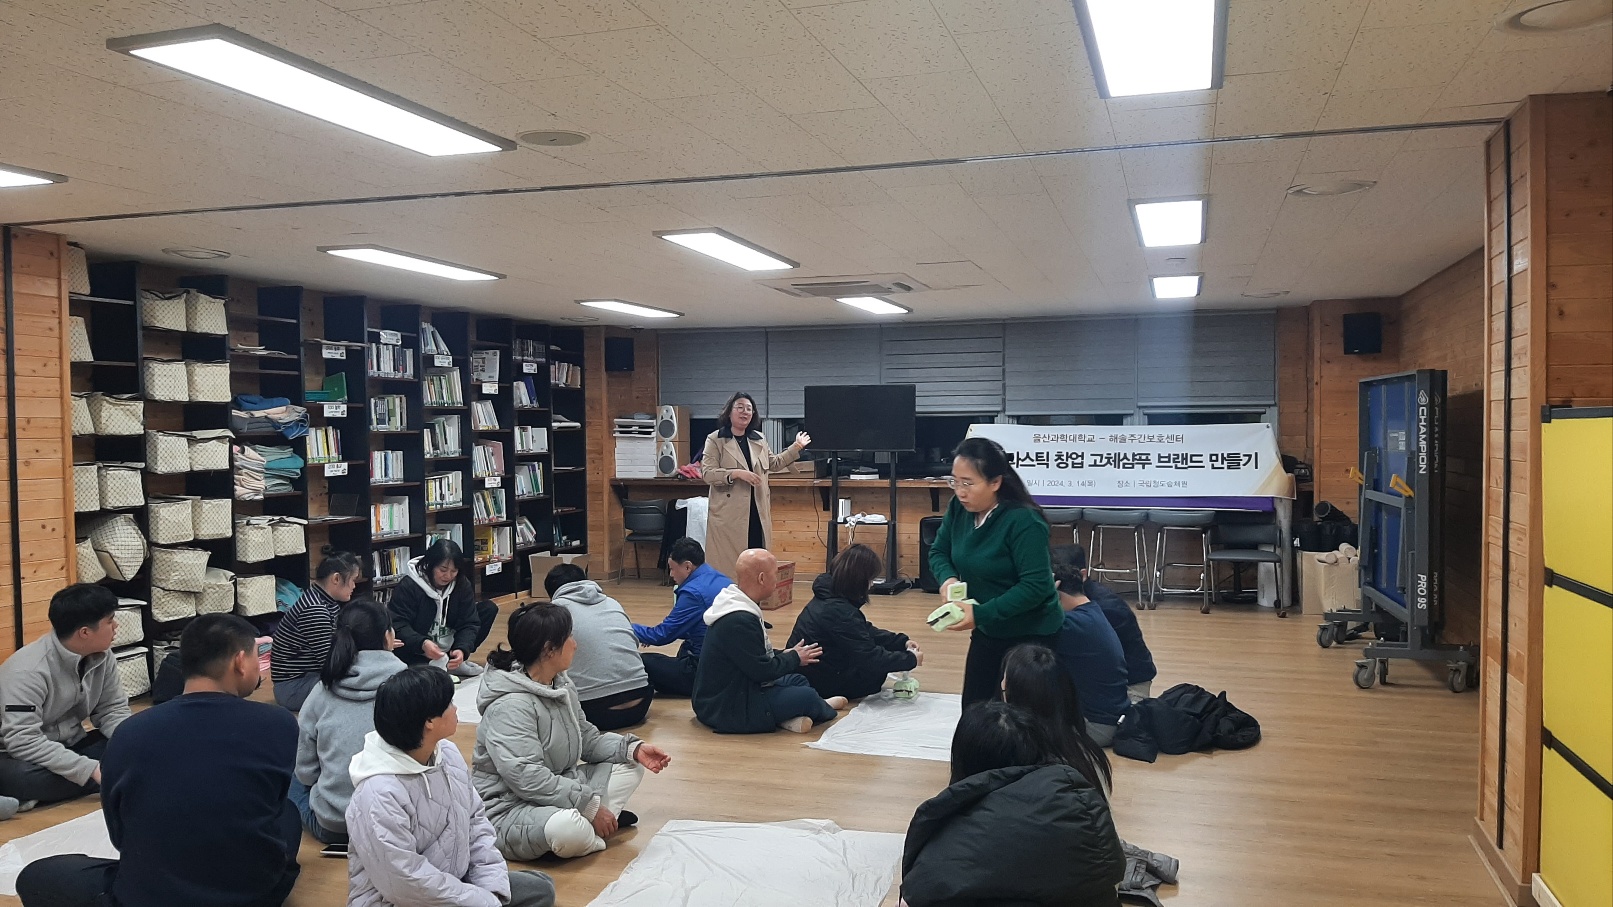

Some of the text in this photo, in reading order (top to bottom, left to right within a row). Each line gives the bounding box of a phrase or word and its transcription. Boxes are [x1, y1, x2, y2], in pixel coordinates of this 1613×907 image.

[1109, 433, 1184, 443] 해솔주간보호센터
[1419, 406, 1427, 474] CHAMPION
[1054, 451, 1084, 469] 창업
[1088, 452, 1152, 469] 고체샴푸
[1155, 452, 1205, 470] 브랜드
[1209, 452, 1259, 470] 만들기
[1417, 573, 1427, 610] PRO 9S
